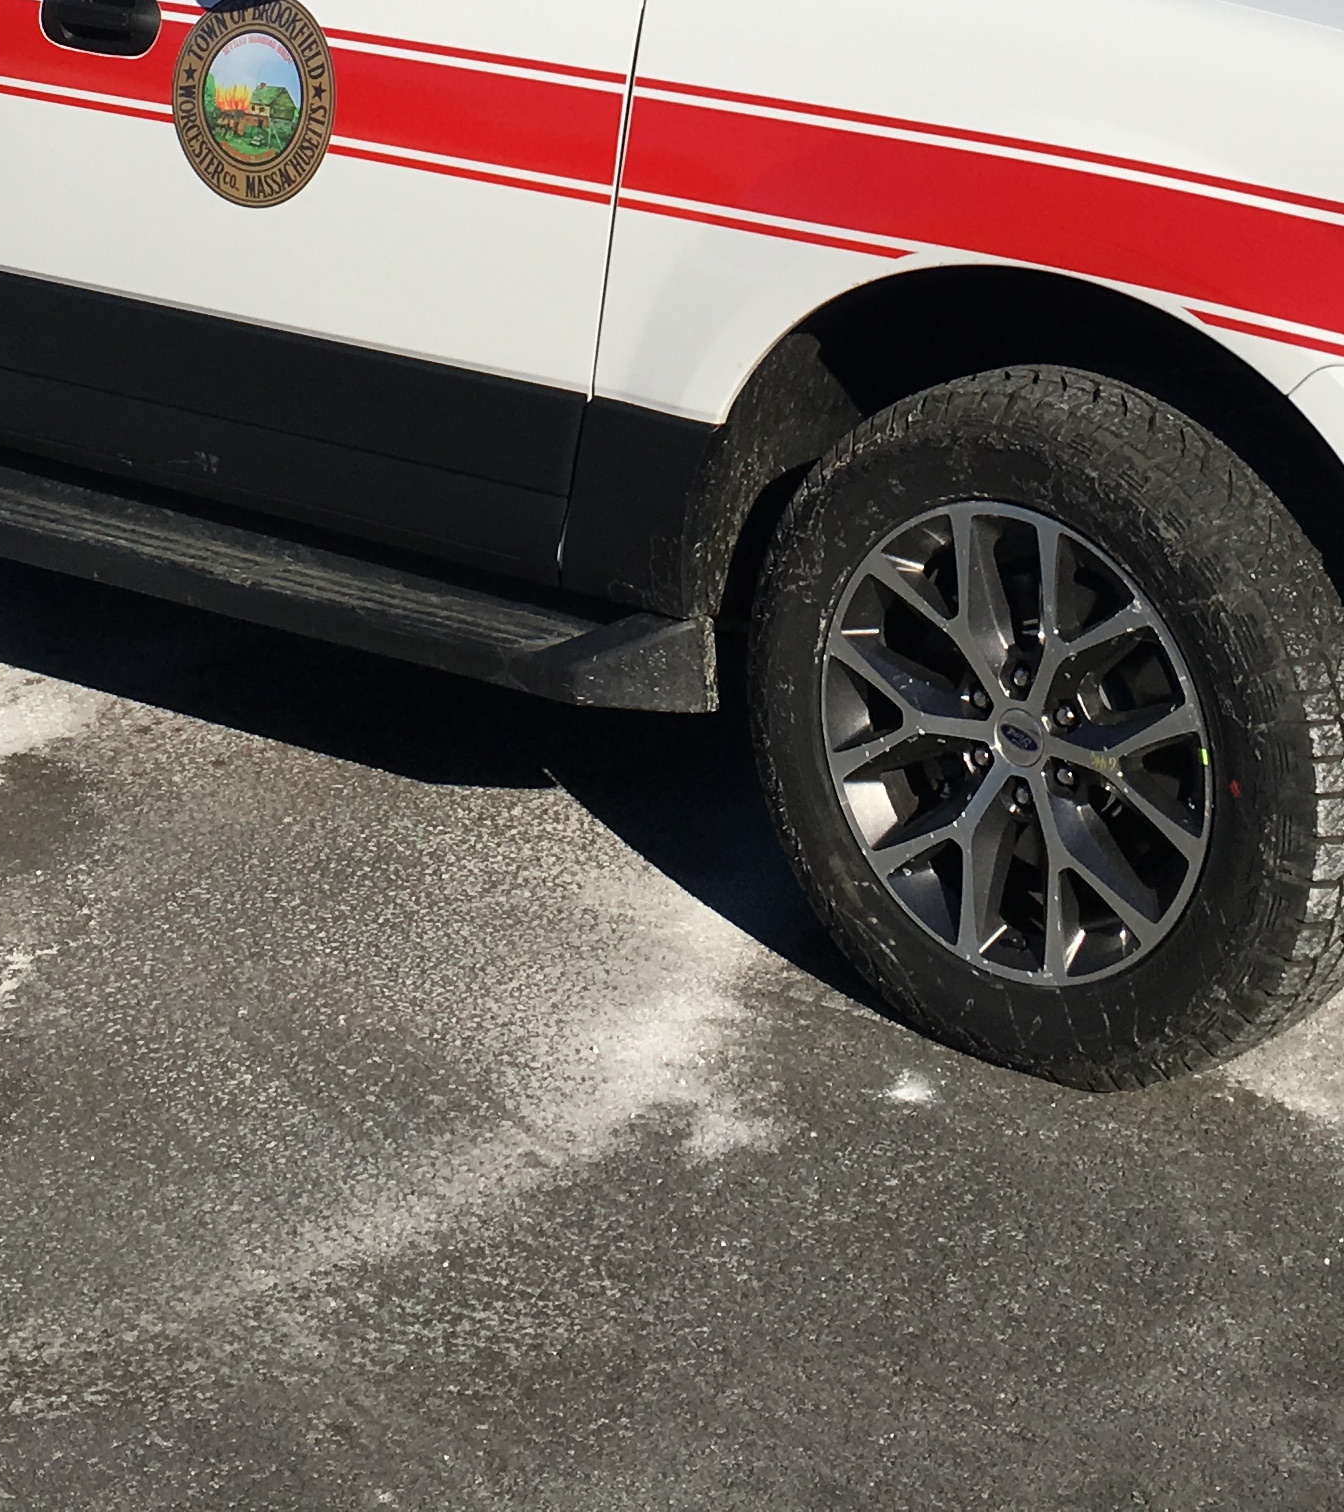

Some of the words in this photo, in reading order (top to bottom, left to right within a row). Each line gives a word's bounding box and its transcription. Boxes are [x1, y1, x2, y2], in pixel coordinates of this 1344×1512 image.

[188, 10, 227, 62] TOWN
[229, 1, 250, 26] OF
[253, 0, 327, 80] BROOKFIELD
[179, 84, 224, 187] WORCESTER
[245, 103, 327, 198] MASSACHUSETTS
